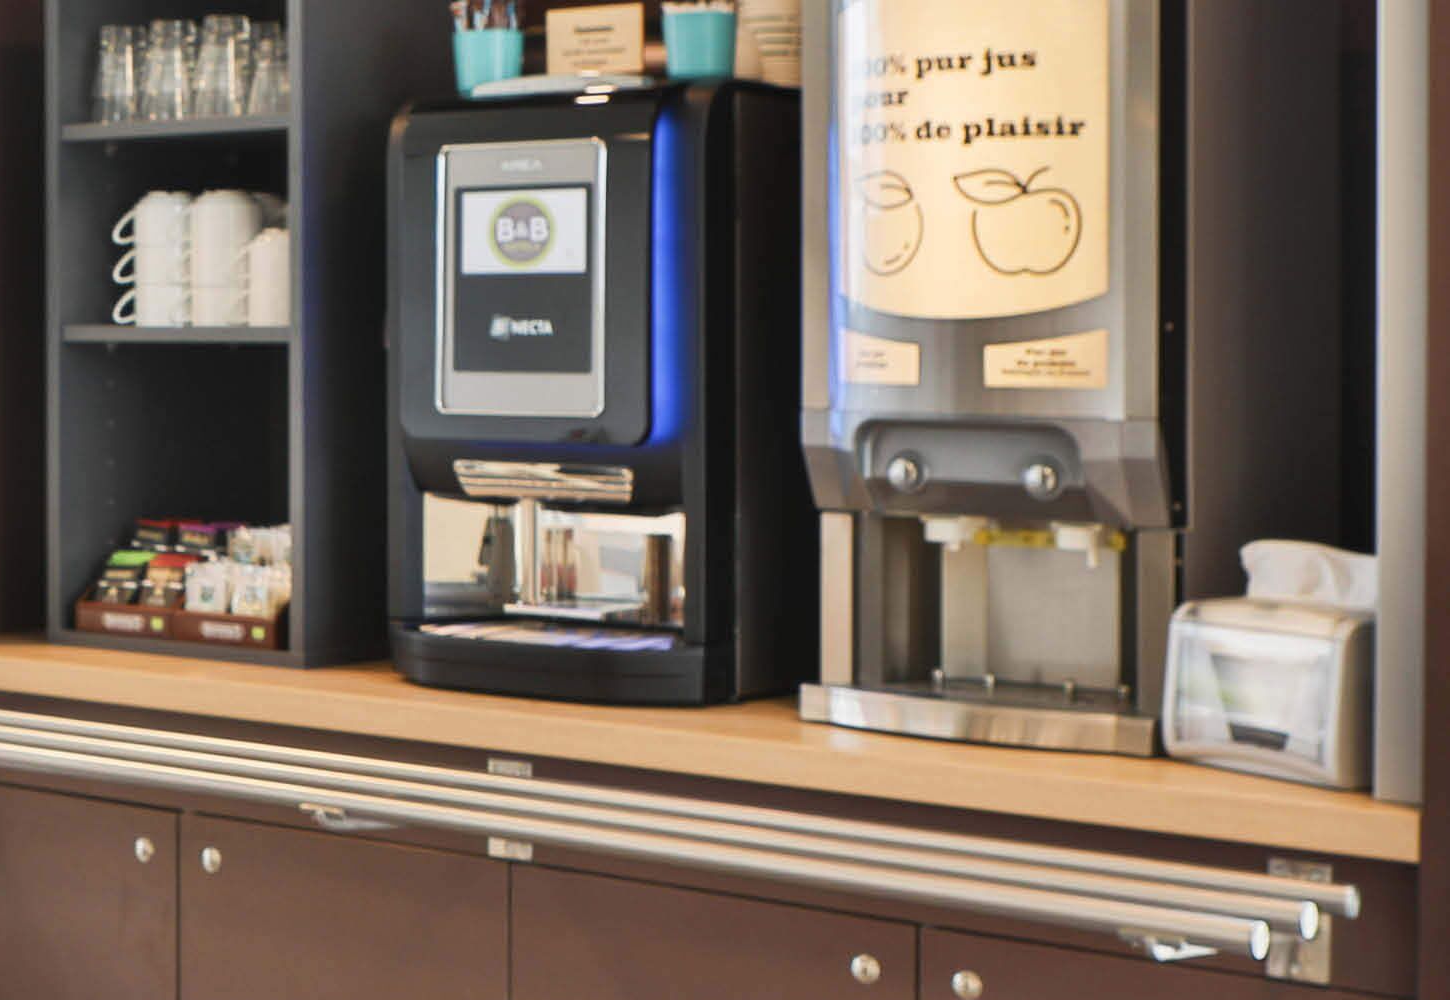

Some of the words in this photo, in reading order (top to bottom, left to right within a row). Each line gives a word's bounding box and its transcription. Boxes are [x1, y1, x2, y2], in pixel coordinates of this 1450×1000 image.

[915, 52, 972, 80] pur
[980, 46, 1037, 76] jus
[856, 90, 909, 112] our
[916, 119, 951, 140] de
[962, 114, 1086, 145] plaisir
